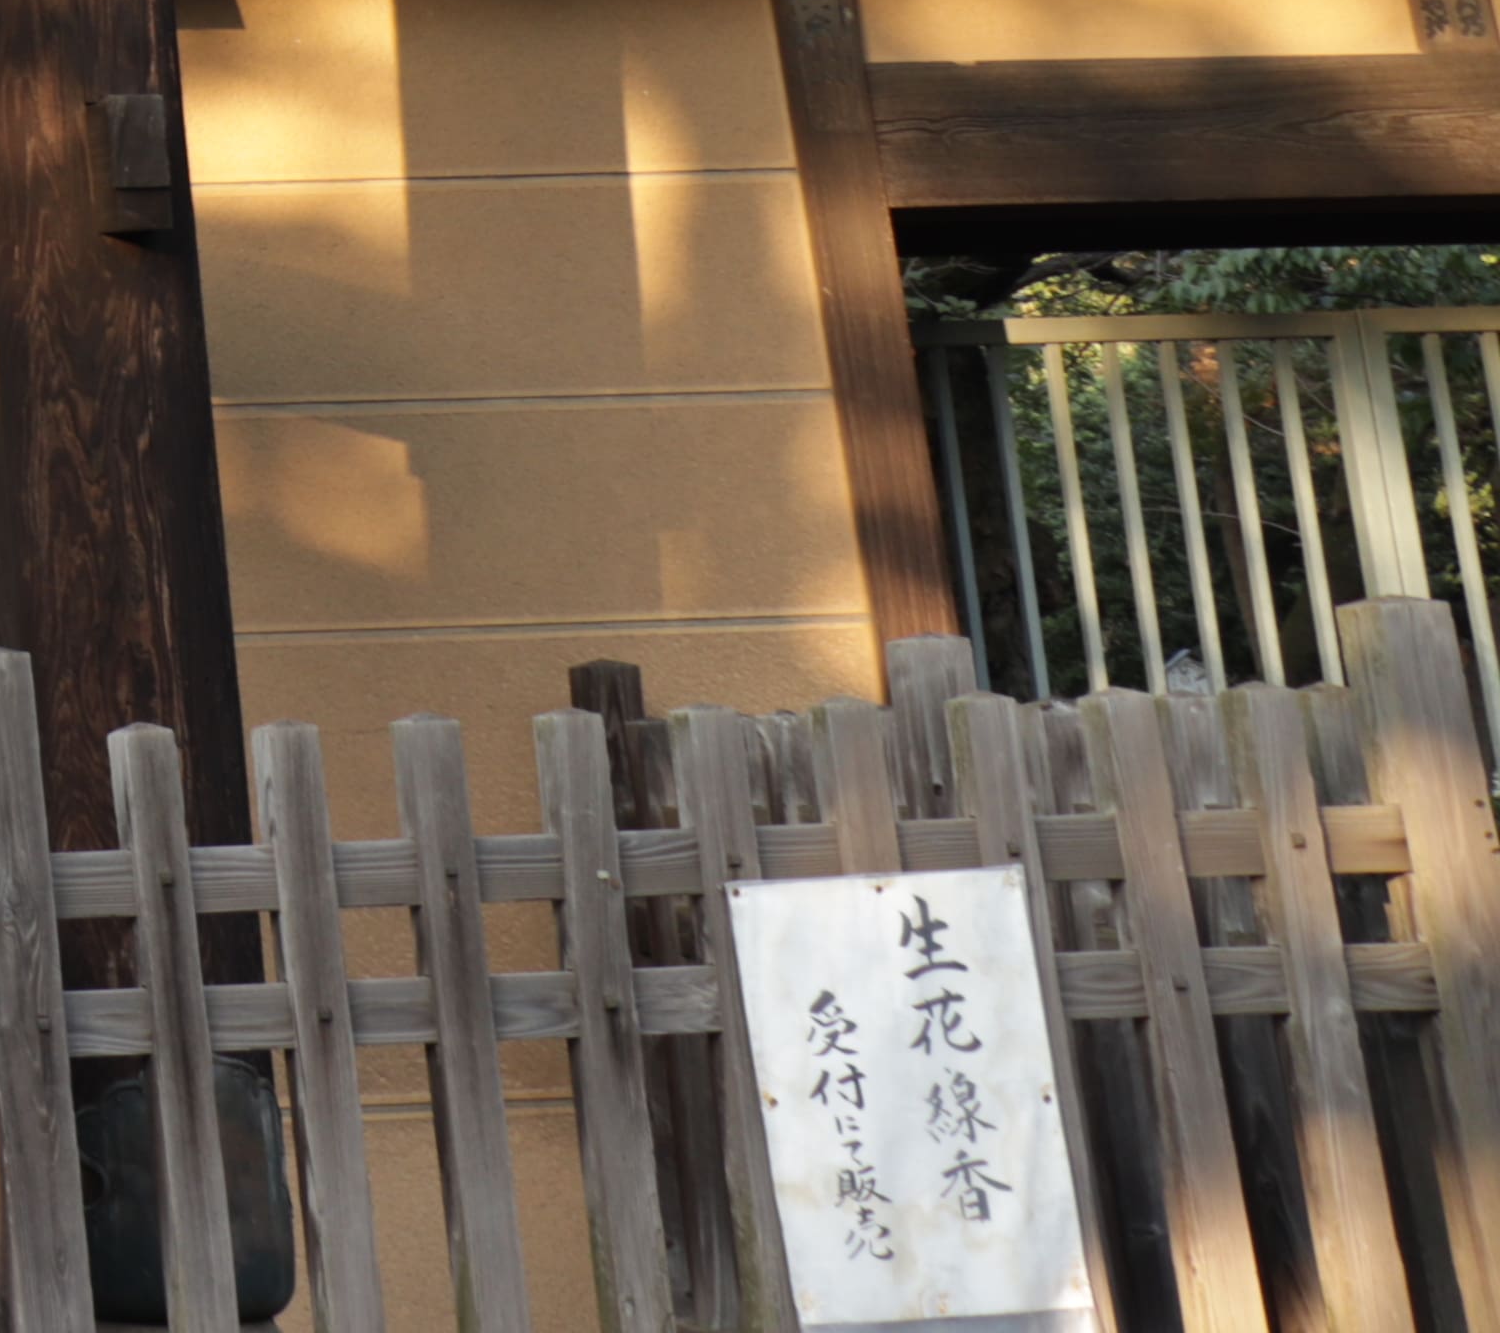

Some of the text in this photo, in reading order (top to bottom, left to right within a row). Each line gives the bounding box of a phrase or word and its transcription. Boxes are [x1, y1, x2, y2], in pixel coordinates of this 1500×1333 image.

[805, 988, 896, 1262] 受付にて販売
[900, 893, 1013, 1225] 生花線香
